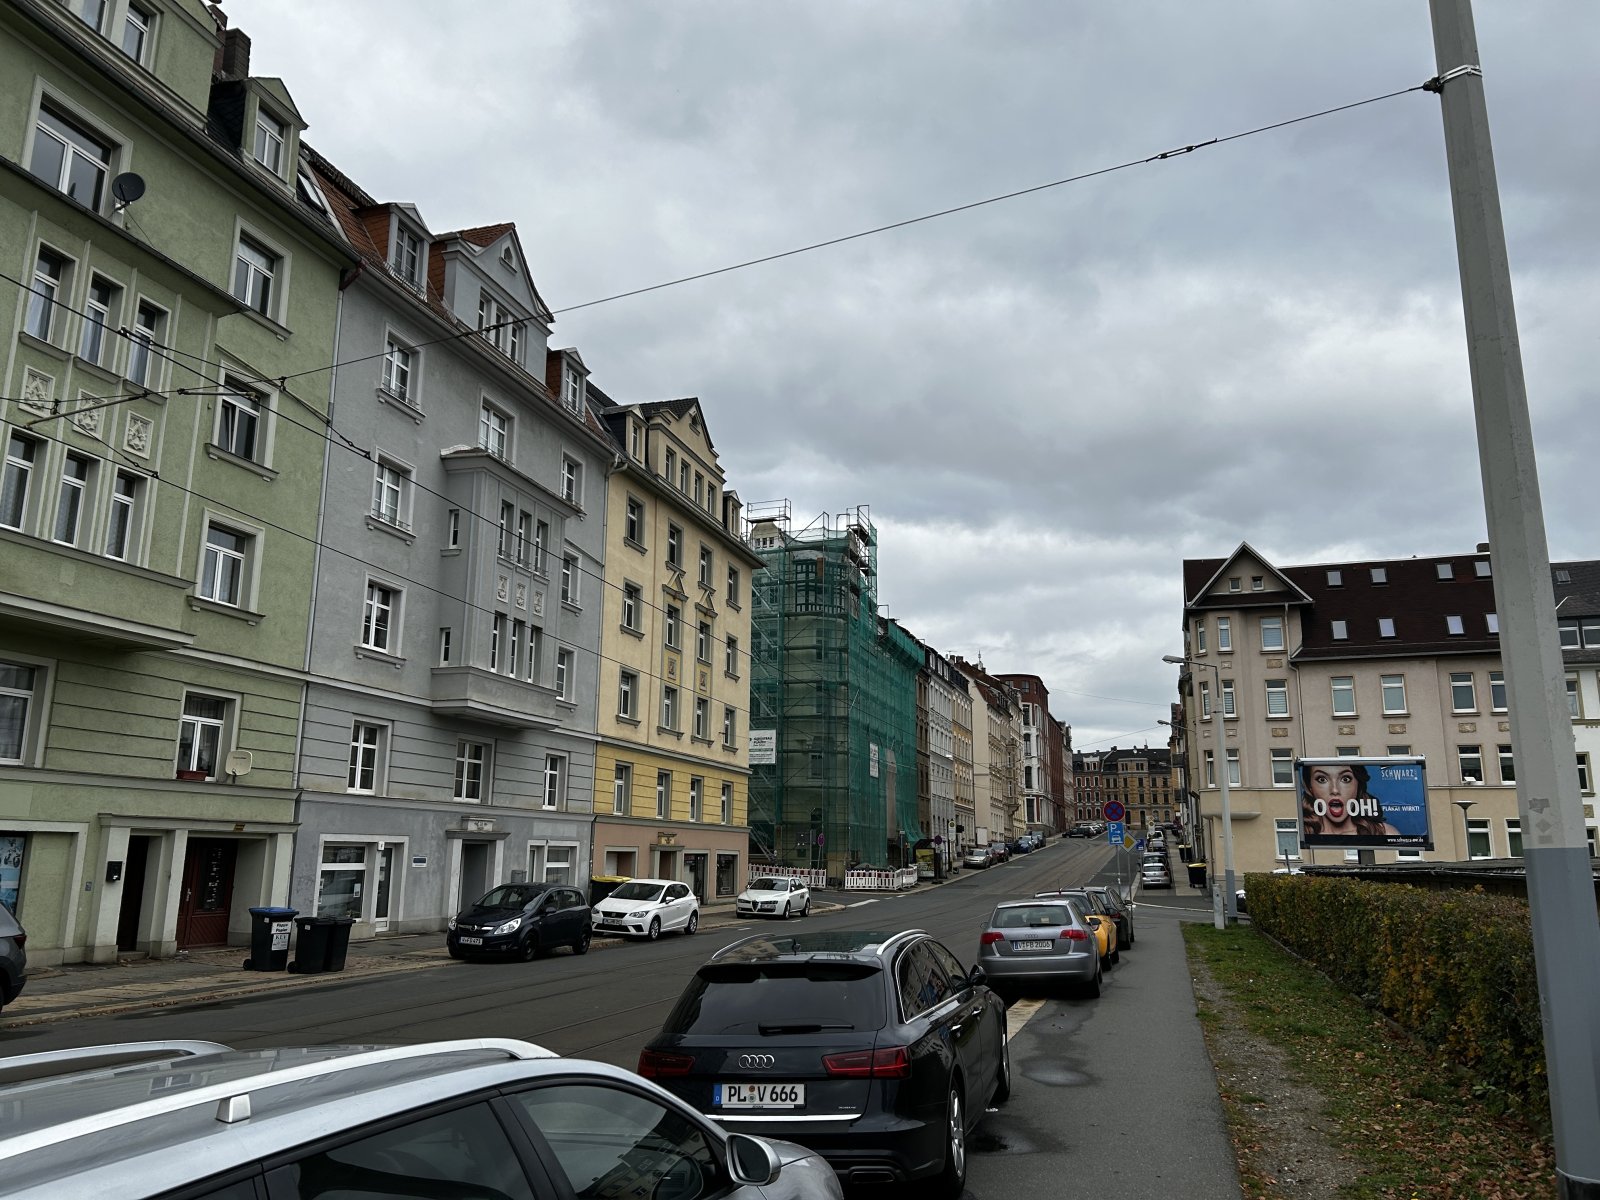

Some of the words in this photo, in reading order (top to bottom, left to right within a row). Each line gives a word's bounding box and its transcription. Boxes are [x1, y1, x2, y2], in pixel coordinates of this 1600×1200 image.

[1381, 770, 1414, 780] SCHWARZ
[1110, 824, 1117, 832] P
[728, 1086, 746, 1102] PL
[758, 1086, 767, 1102] V
[770, 1086, 798, 1102] 666
